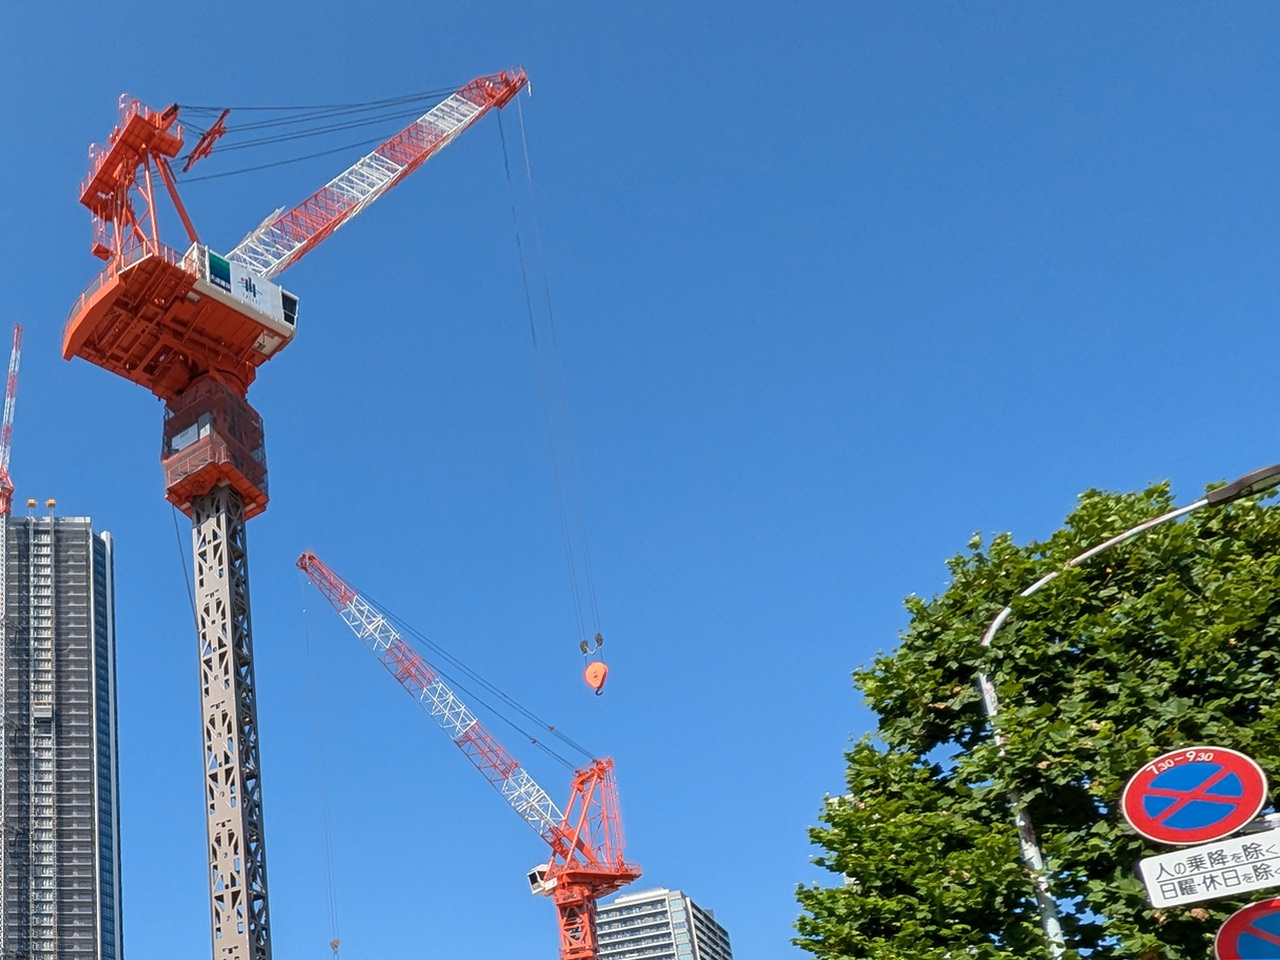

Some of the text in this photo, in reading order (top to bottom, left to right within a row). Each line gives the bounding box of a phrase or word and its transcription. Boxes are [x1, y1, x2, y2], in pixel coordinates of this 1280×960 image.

[1155, 841, 1279, 881] 人の乗降を除く
